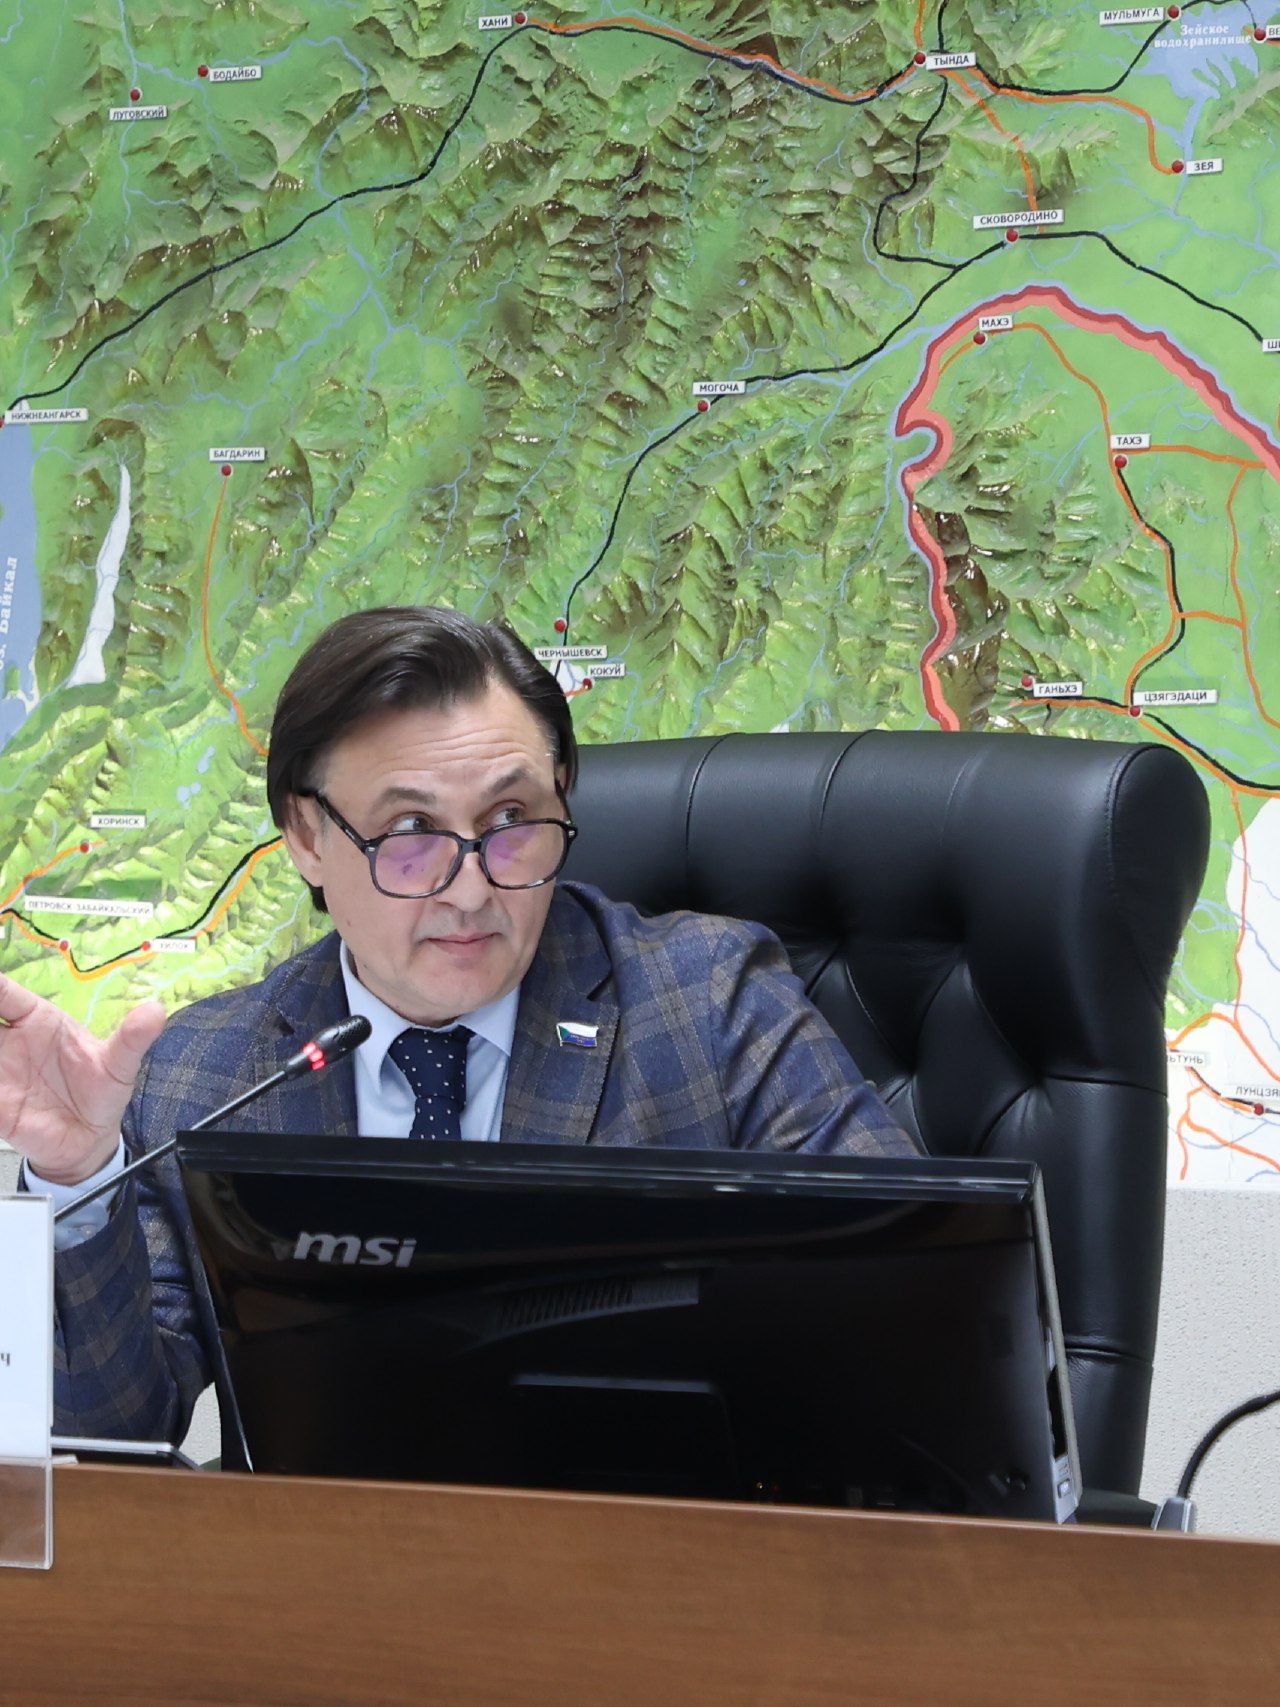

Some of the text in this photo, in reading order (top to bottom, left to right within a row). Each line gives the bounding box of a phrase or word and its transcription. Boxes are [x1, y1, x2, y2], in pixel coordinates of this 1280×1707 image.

[1104, 7, 1160, 20] МУЛЬМУГА
[481, 17, 508, 28] ХАНИ
[1180, 24, 1229, 36] Зейское
[1269, 27, 1280, 36] ВЕ
[1154, 35, 1251, 50] водохранилище
[934, 55, 969, 66] ТЫНДА
[213, 67, 257, 80] БОДАЙБО
[112, 106, 164, 120] ЛУГОВСКИЙ
[1194, 161, 1214, 171] ЗЕЯ
[980, 211, 1058, 225] СКОВОРОДИНО
[981, 318, 1009, 328] МАХЭ
[699, 384, 739, 393] МОГОЧА
[11, 410, 81, 420] НИЖНЕАНГАРСК
[1117, 436, 1142, 445] ТАХЭ
[213, 450, 260, 459] БАГДАРИН
[538, 647, 602, 658] ЧЕРНЫШЕВСК
[590, 664, 621, 676] КОКУЙ
[1038, 685, 1078, 694] ГАНЬХЭ
[1144, 692, 1207, 703] ЦЗЯГЭДАЦИ
[98, 817, 139, 826] ХОРИНСК
[1169, 1055, 1204, 1065] ЬТУНЬ
[1235, 1086, 1280, 1098] ЛУНЦЗЯ
[293, 1231, 417, 1267] msi
